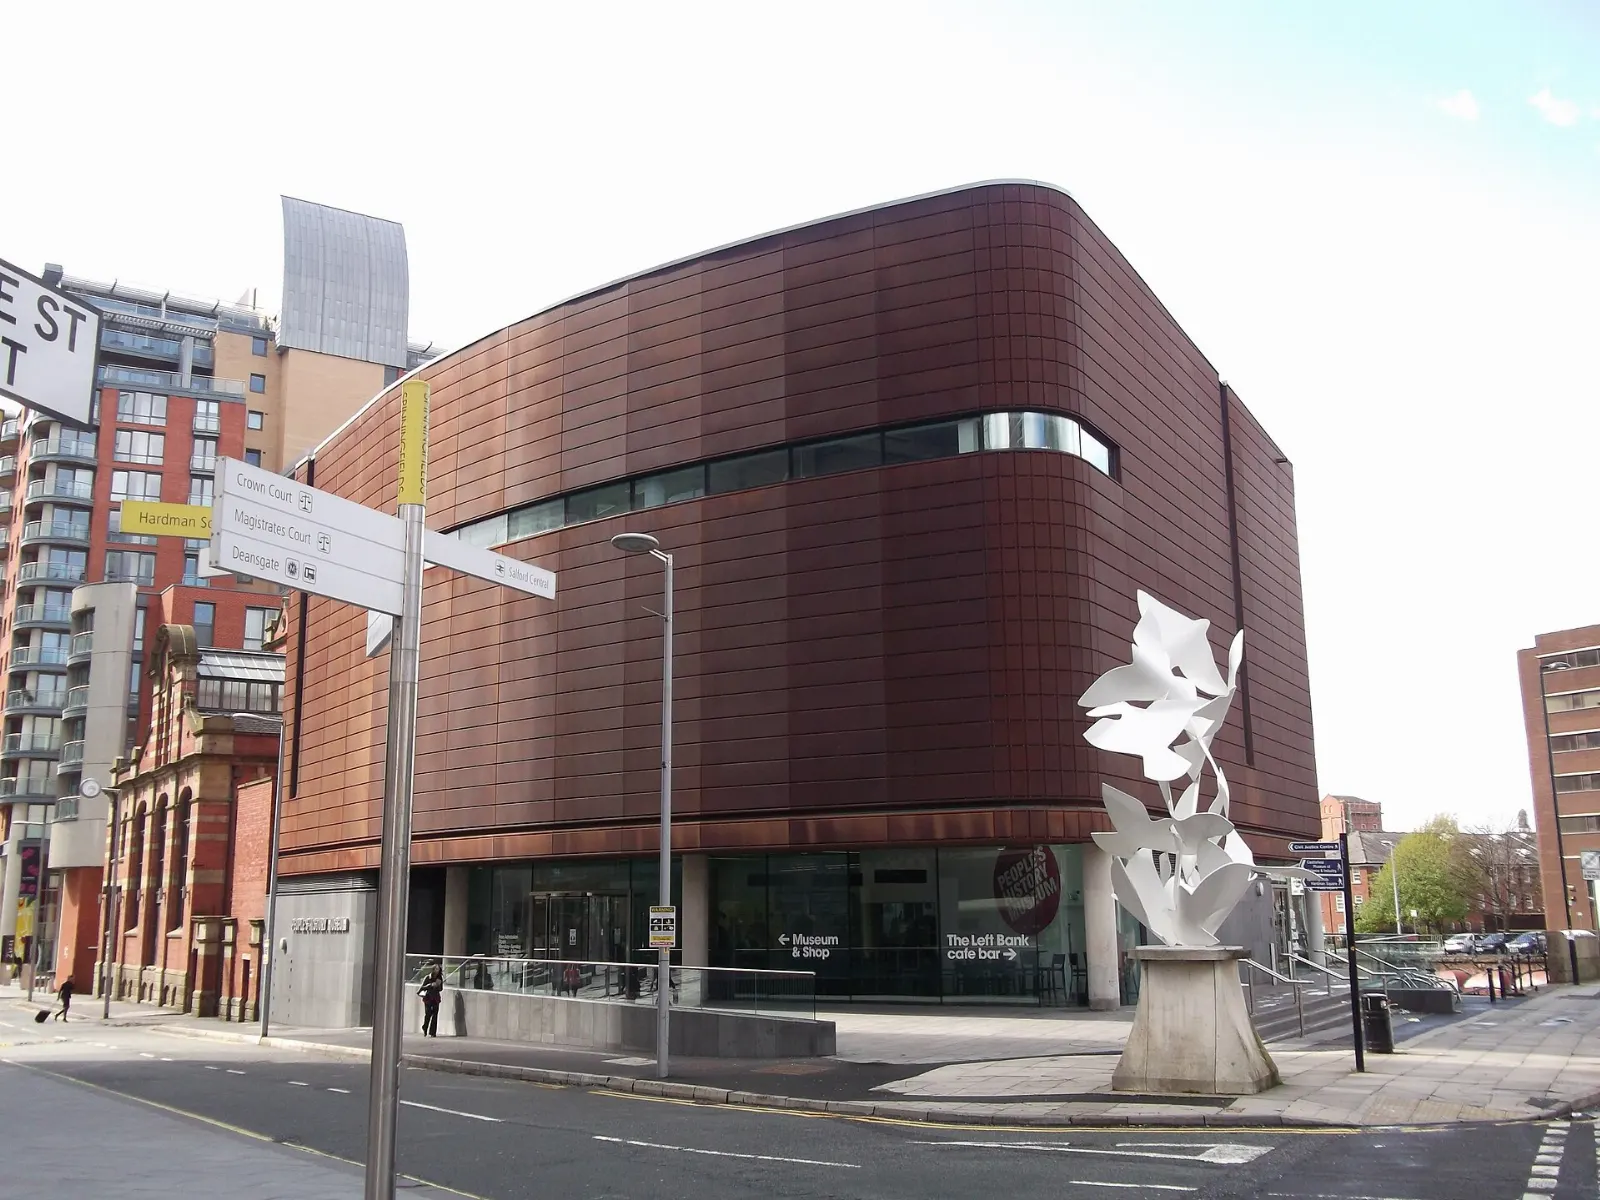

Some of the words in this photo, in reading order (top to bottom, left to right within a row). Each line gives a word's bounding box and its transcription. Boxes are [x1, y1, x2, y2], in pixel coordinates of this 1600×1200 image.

[1, 336, 28, 387] T
[236, 472, 266, 495] Crown
[268, 484, 293, 504] Court
[139, 512, 196, 528] Hardman
[234, 508, 286, 537] Magistrates
[288, 525, 312, 546] Court
[232, 545, 280, 573] Deansgate
[508, 565, 530, 583] Salford
[530, 573, 550, 590] Central
[792, 933, 839, 946] Museum
[947, 934, 970, 947] The
[971, 934, 995, 947] Left
[996, 934, 1030, 947] Bank
[792, 946, 800, 958] &
[802, 946, 830, 960] Shop
[947, 947, 975, 960] cafe
[978, 947, 1001, 960] bar
